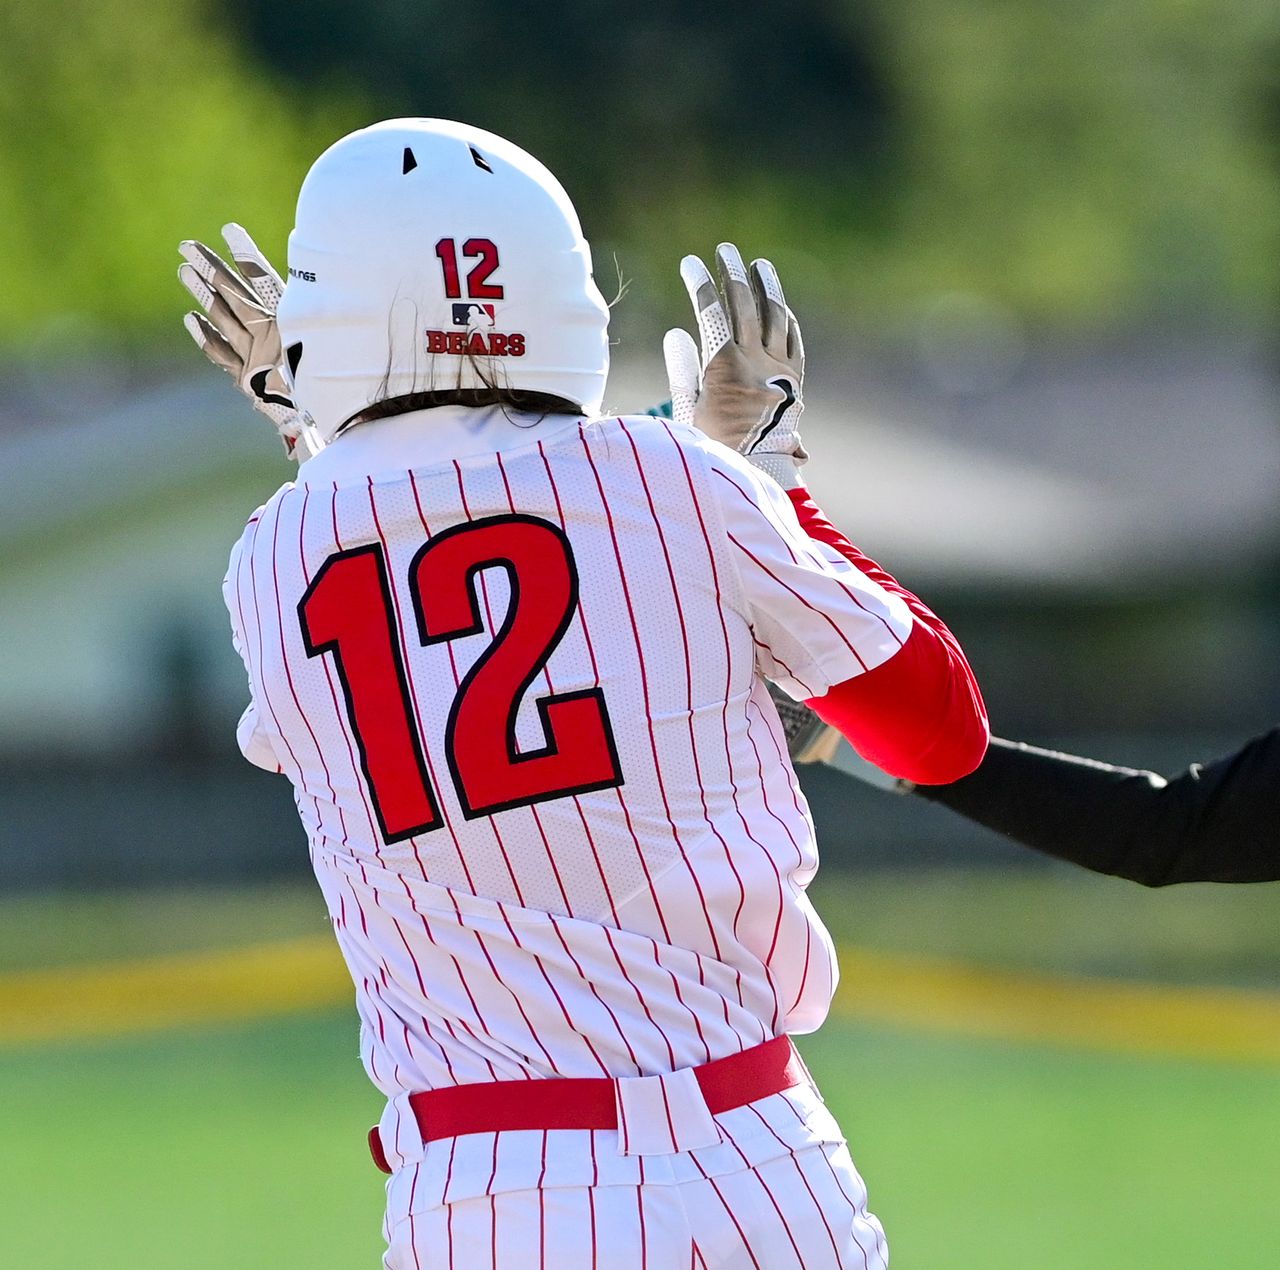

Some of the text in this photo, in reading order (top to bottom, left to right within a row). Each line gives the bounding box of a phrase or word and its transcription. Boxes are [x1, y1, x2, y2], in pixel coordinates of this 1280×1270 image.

[435, 238, 504, 300] 12
[426, 330, 526, 357] BEARS
[297, 513, 625, 846] 12
